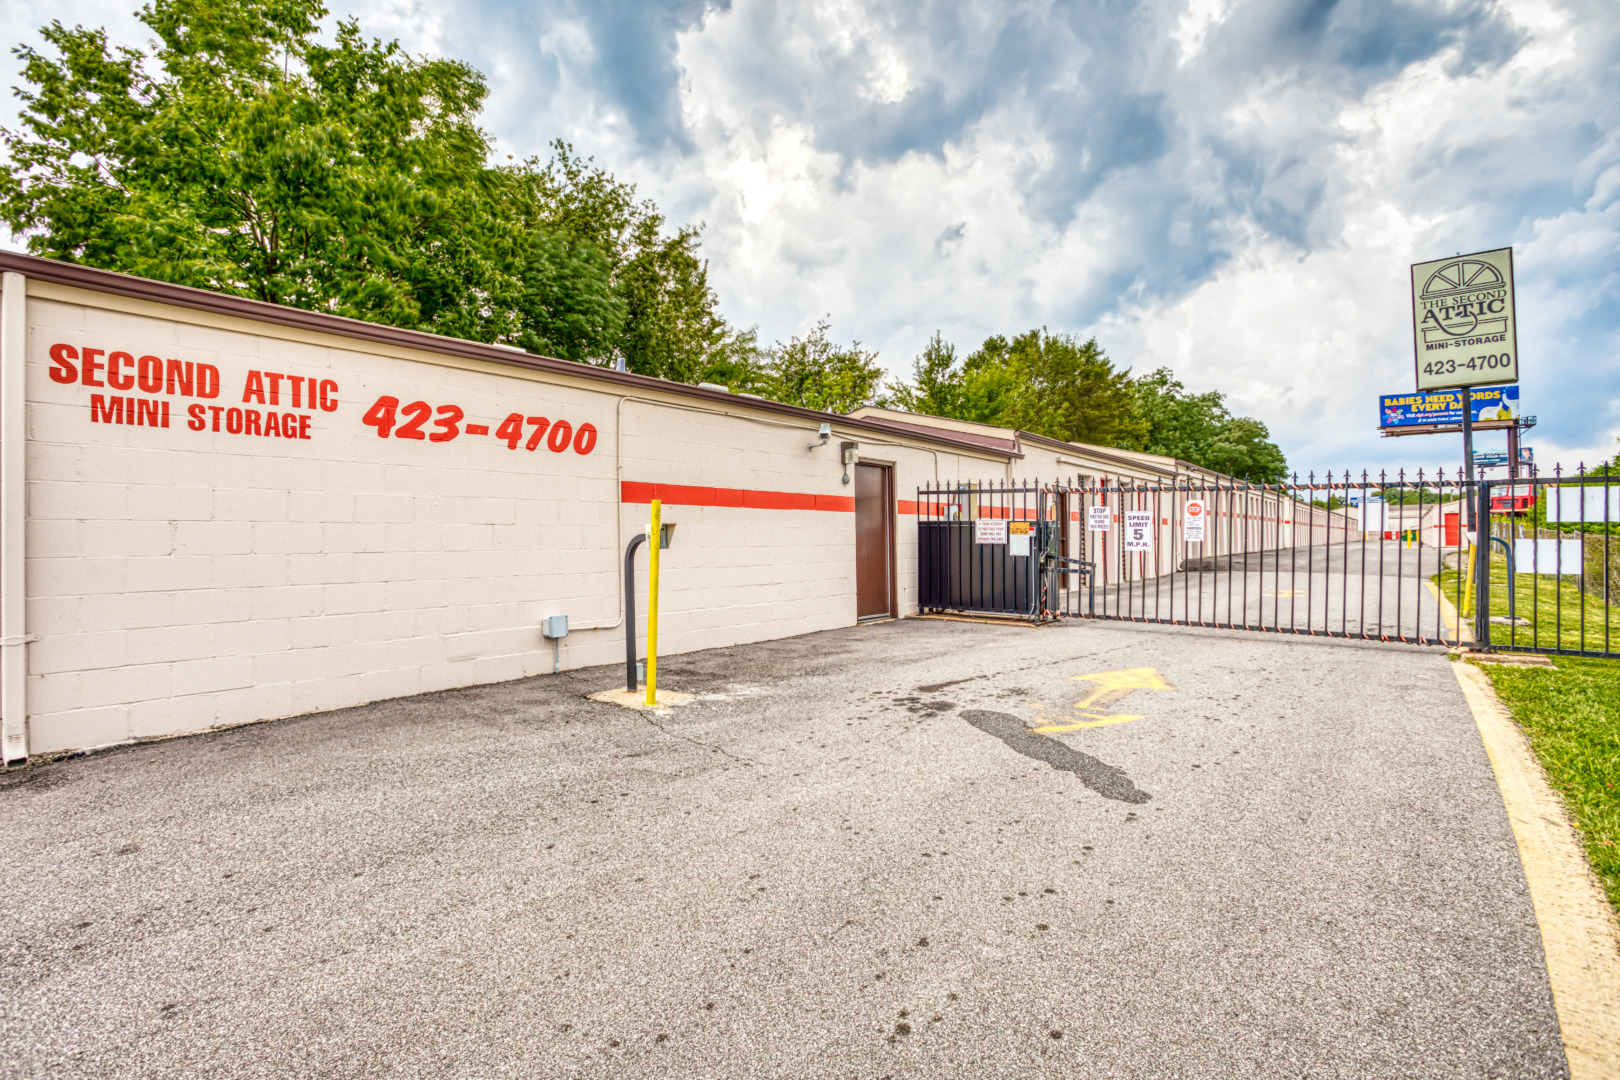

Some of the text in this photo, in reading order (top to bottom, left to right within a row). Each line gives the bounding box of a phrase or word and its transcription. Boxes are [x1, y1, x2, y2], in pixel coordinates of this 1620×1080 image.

[1420, 289, 1507, 310] THE SECOND
[1421, 298, 1505, 330] ATTIC
[1426, 334, 1507, 351] MINI-STORAGE
[1423, 353, 1511, 376] 423-4700
[49, 343, 339, 412] SECOND ATTIC
[1384, 396, 1423, 406] BABIES
[1425, 393, 1455, 403] NEED
[1411, 401, 1464, 412] EVERY DA
[90, 393, 312, 440] MINI STORAGE
[362, 395, 598, 456] 423-4700
[1133, 528, 1144, 540] 5
